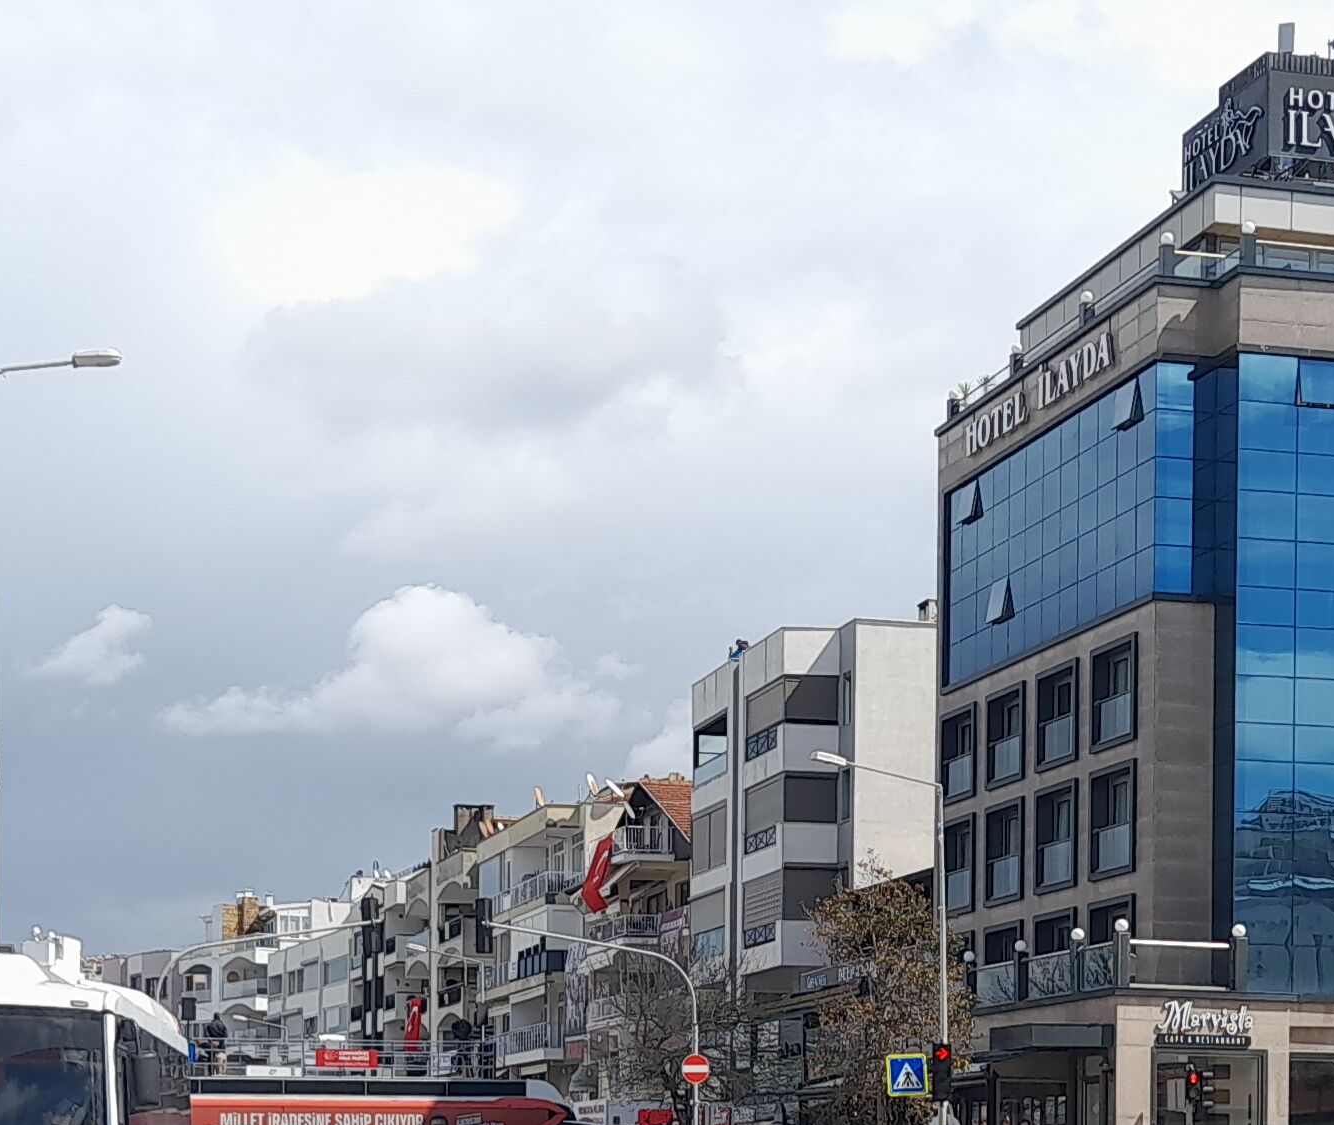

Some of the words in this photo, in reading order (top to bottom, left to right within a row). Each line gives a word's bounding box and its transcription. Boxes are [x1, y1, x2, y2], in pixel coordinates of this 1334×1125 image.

[1183, 124, 1220, 163] HOTEL
[965, 391, 1026, 457] HOTEL
[1037, 332, 1111, 410] İLAYDA
[1157, 1000, 1254, 1035] Marvista
